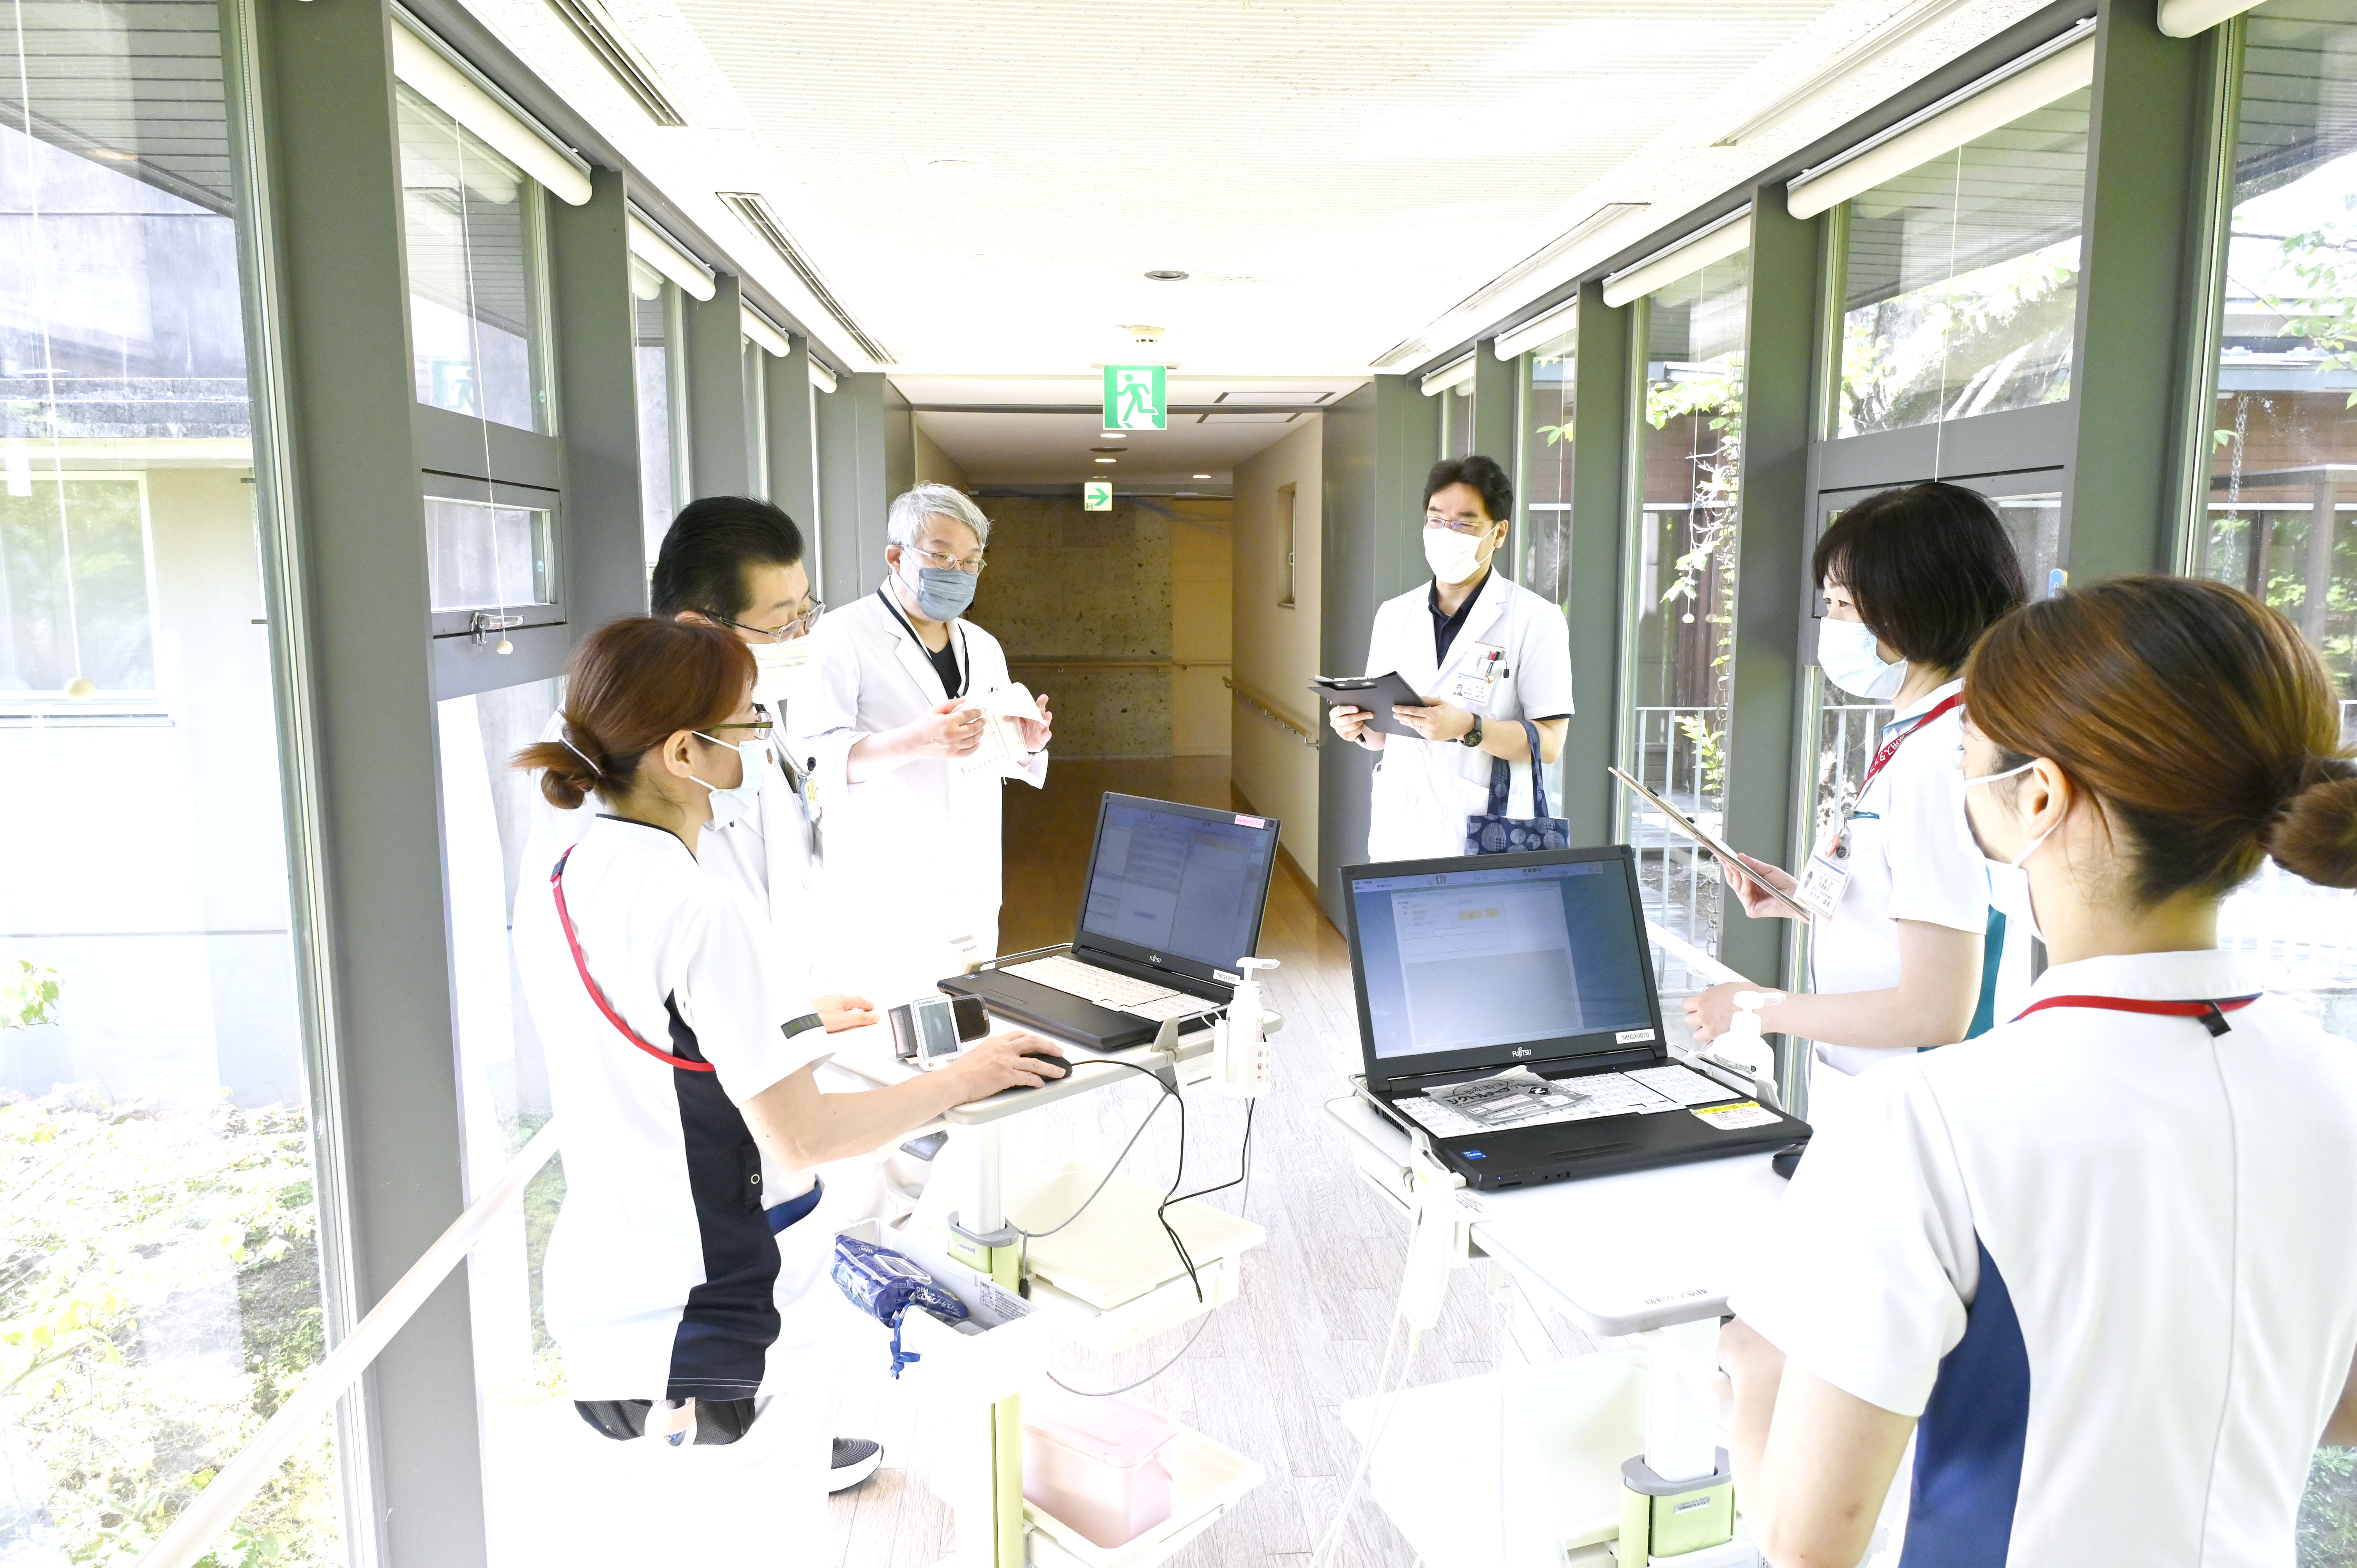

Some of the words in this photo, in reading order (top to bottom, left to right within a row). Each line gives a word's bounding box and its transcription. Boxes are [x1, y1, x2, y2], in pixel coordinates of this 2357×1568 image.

[1149, 954, 1161, 963] FUJITSU
[1217, 973, 1236, 982] NBGX0071
[1622, 1032, 1649, 1040] NBGX0070
[1512, 1047, 1532, 1058] FUJITSU
[1446, 1088, 1510, 1105] ジクトルテープ
[1679, 1501, 1705, 1510] okamura
